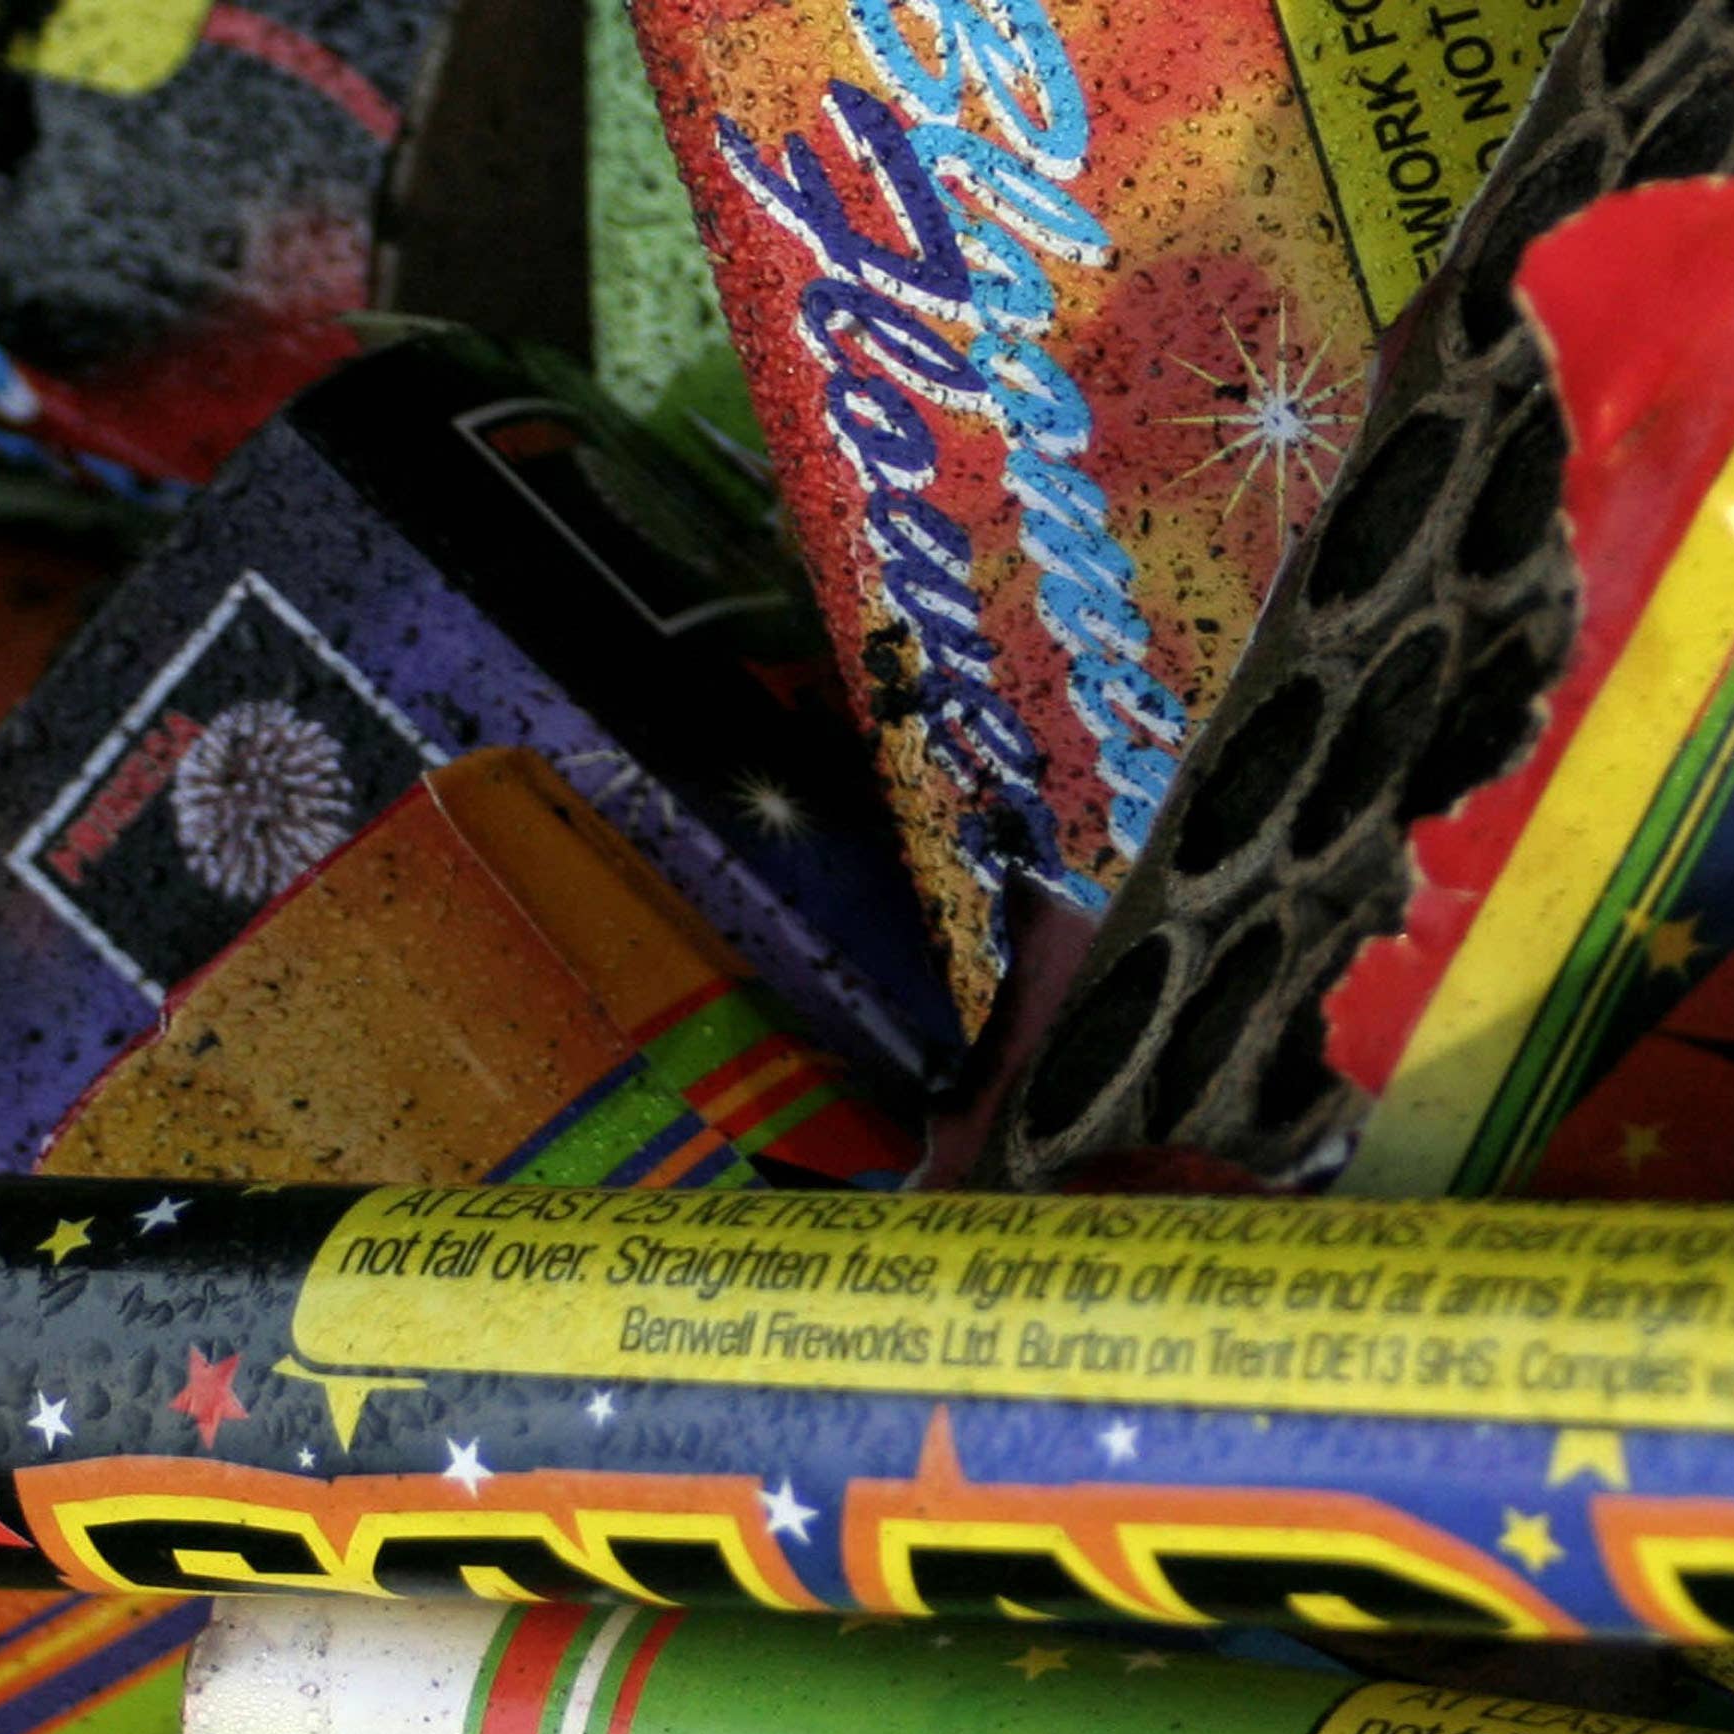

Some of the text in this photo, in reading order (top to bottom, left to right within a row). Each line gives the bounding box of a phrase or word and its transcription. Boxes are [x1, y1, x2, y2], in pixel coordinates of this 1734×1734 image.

[1428, 6, 1510, 123] NOT
[338, 1232, 423, 1276] not
[420, 1230, 495, 1278] fall
[491, 1241, 602, 1283] over.
[605, 1235, 831, 1300] Straighten
[836, 1241, 940, 1304] fuse,
[955, 1246, 1065, 1311] light
[1064, 1253, 1126, 1314] tip
[1127, 1252, 1194, 1300] of
[1188, 1254, 1278, 1310] free
[1282, 1262, 1387, 1311] end
[1379, 1268, 1441, 1314] at
[1434, 1272, 1567, 1319] arms
[619, 1306, 757, 1358] Benwell
[763, 1309, 932, 1365] Fireworks
[1016, 1320, 1139, 1372] Burton
[1143, 1334, 1197, 1376] on
[1207, 1326, 1295, 1379] Trent
[1300, 1329, 1410, 1384] DE13
